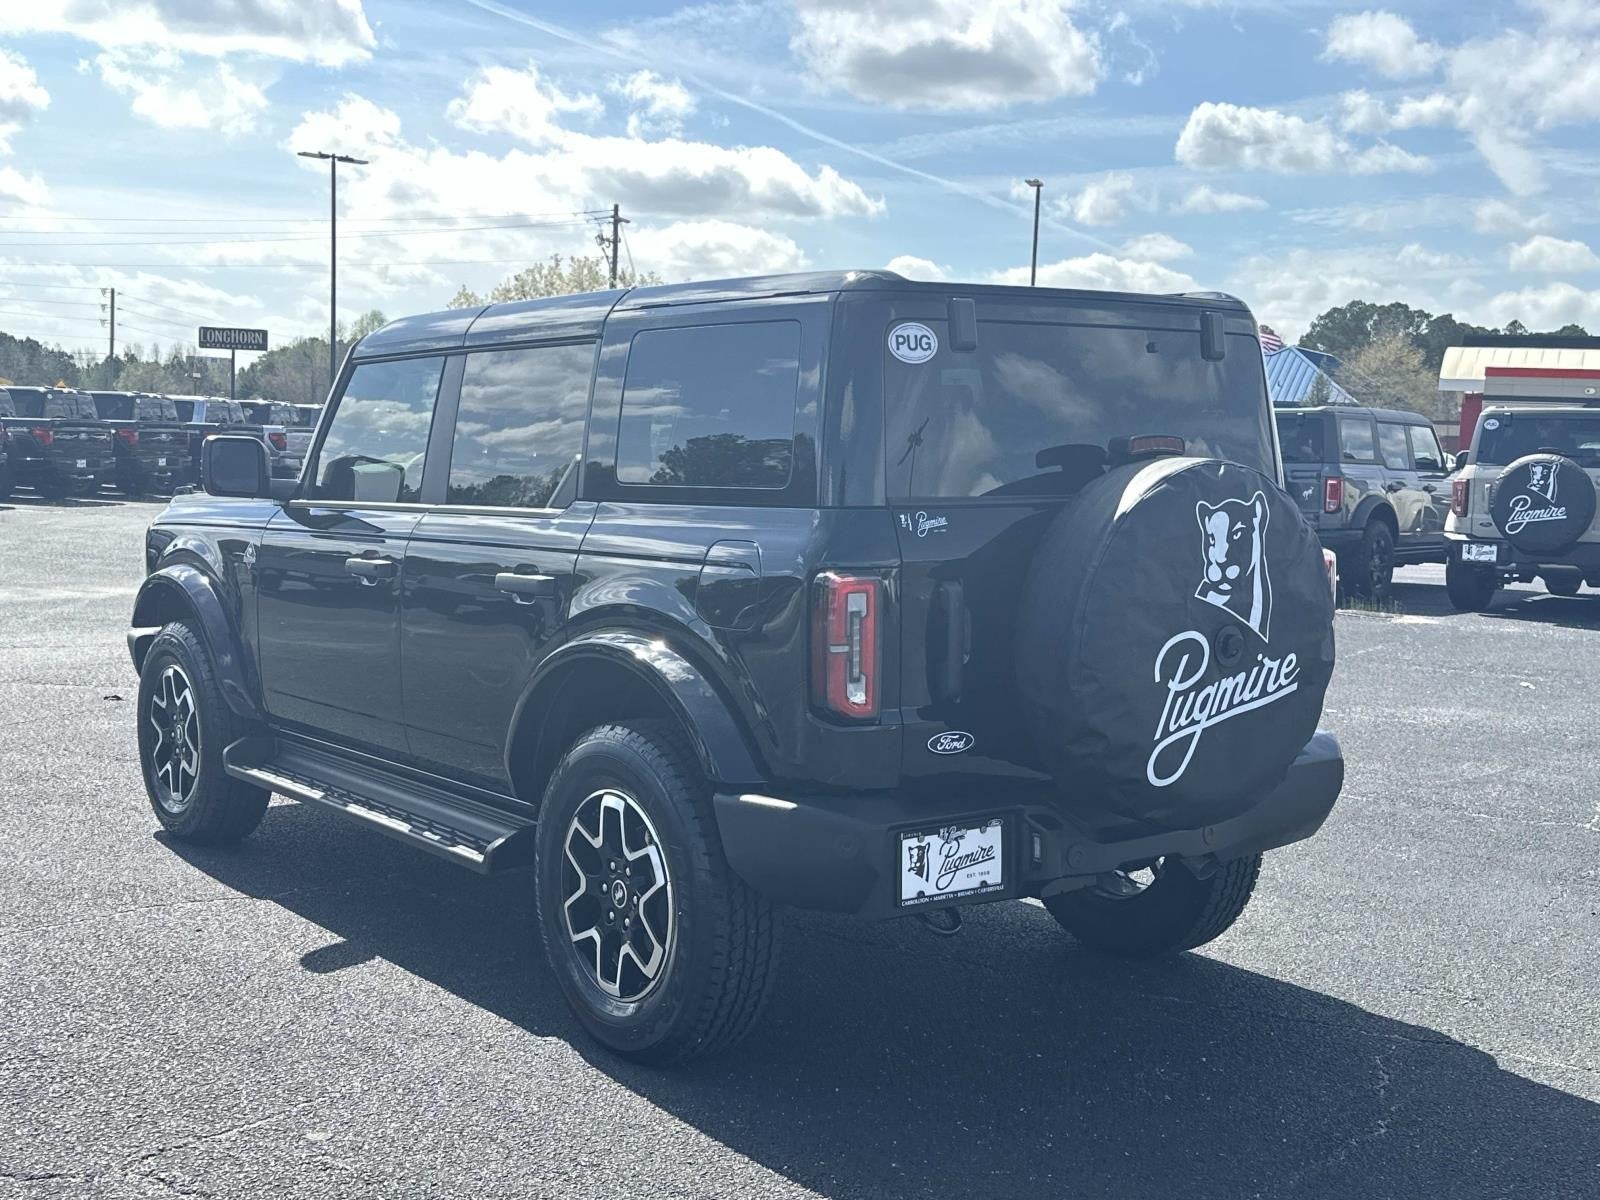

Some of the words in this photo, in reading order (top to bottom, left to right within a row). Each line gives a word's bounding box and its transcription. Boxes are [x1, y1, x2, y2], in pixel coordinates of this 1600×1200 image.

[200, 328, 263, 344] LONGHORN
[895, 334, 931, 351] PUG
[1505, 495, 1567, 535] Pugmire
[1147, 630, 1301, 787] Pugmire
[937, 735, 966, 750] Ford
[936, 839, 995, 891] Pugmire
